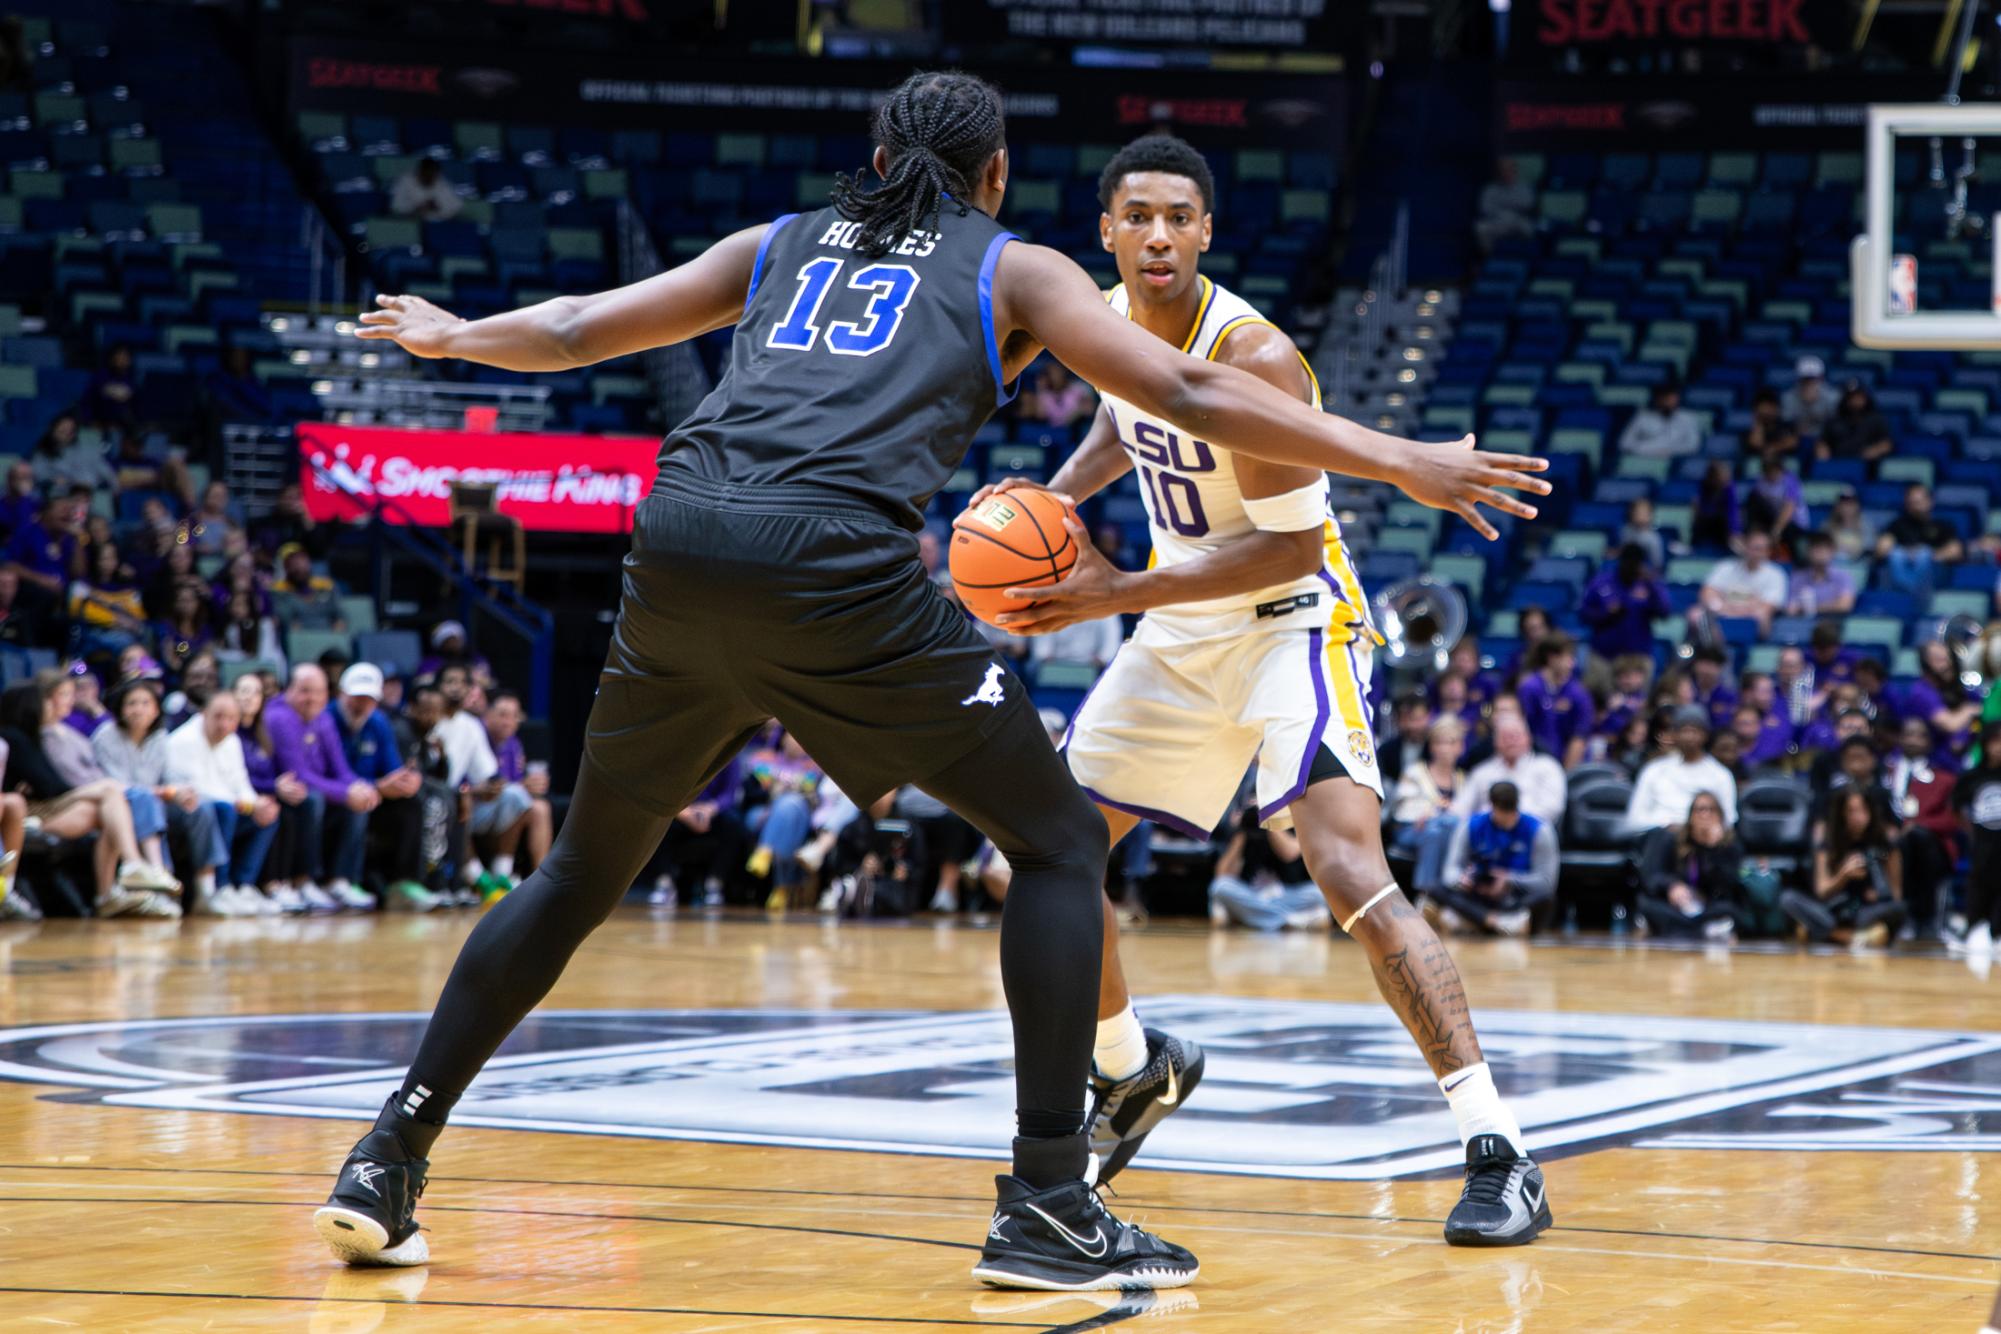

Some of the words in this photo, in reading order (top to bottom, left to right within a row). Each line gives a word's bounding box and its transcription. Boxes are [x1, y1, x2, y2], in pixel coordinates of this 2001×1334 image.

[1538, 0, 1809, 44] SEATGEEK
[818, 221, 943, 257] HOES
[765, 256, 921, 357] 13
[1141, 465, 1210, 537] 10
